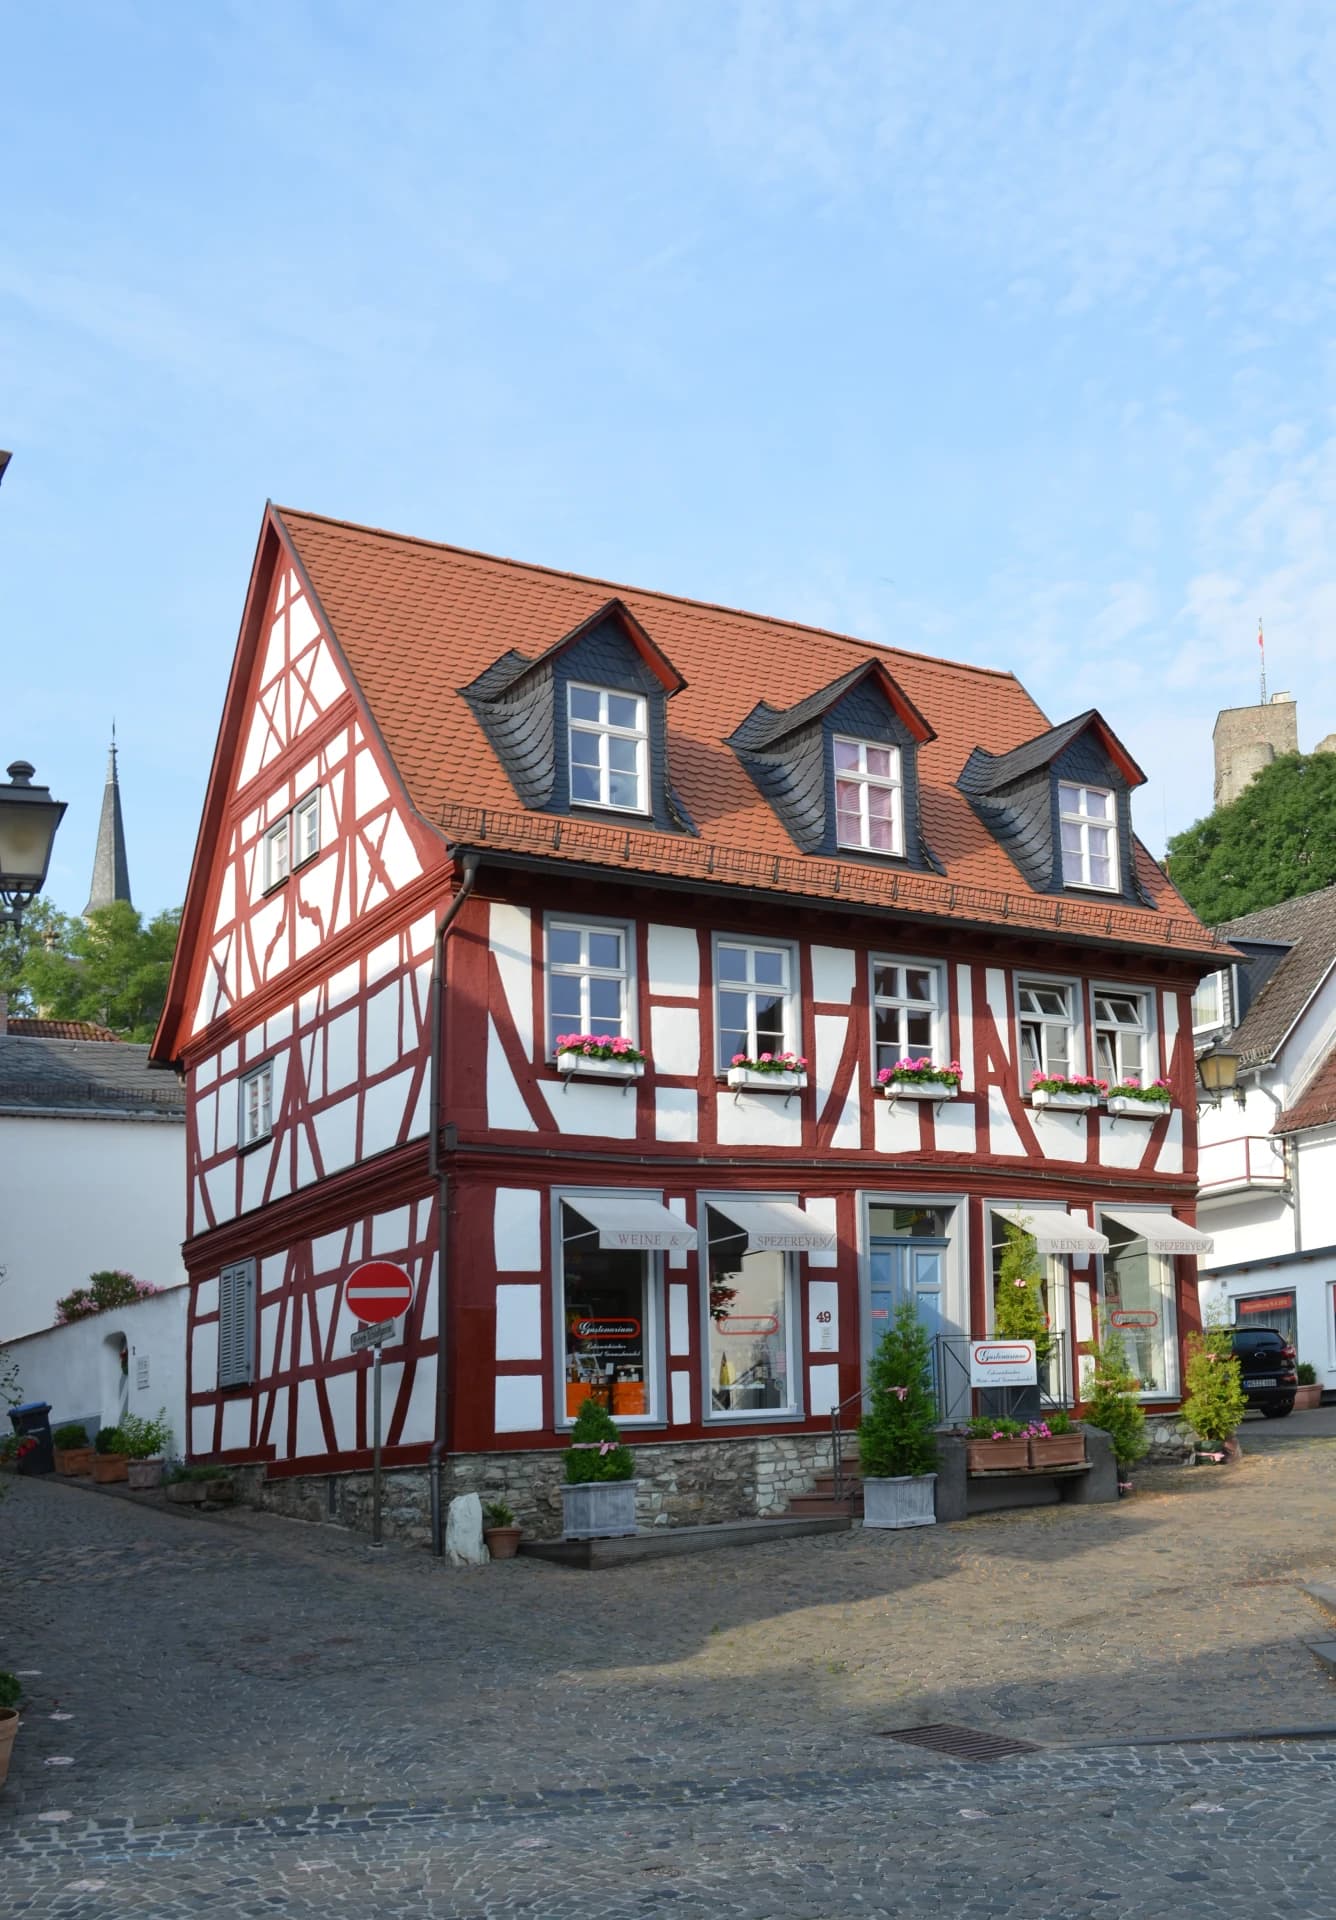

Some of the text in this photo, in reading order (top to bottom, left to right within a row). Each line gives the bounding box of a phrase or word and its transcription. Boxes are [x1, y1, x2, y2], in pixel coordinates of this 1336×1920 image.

[617, 1233, 680, 1246] WEINE &
[757, 1235, 828, 1247] SPEZEREYEN
[1050, 1239, 1097, 1250] WEINE &
[816, 1311, 831, 1323] 49
